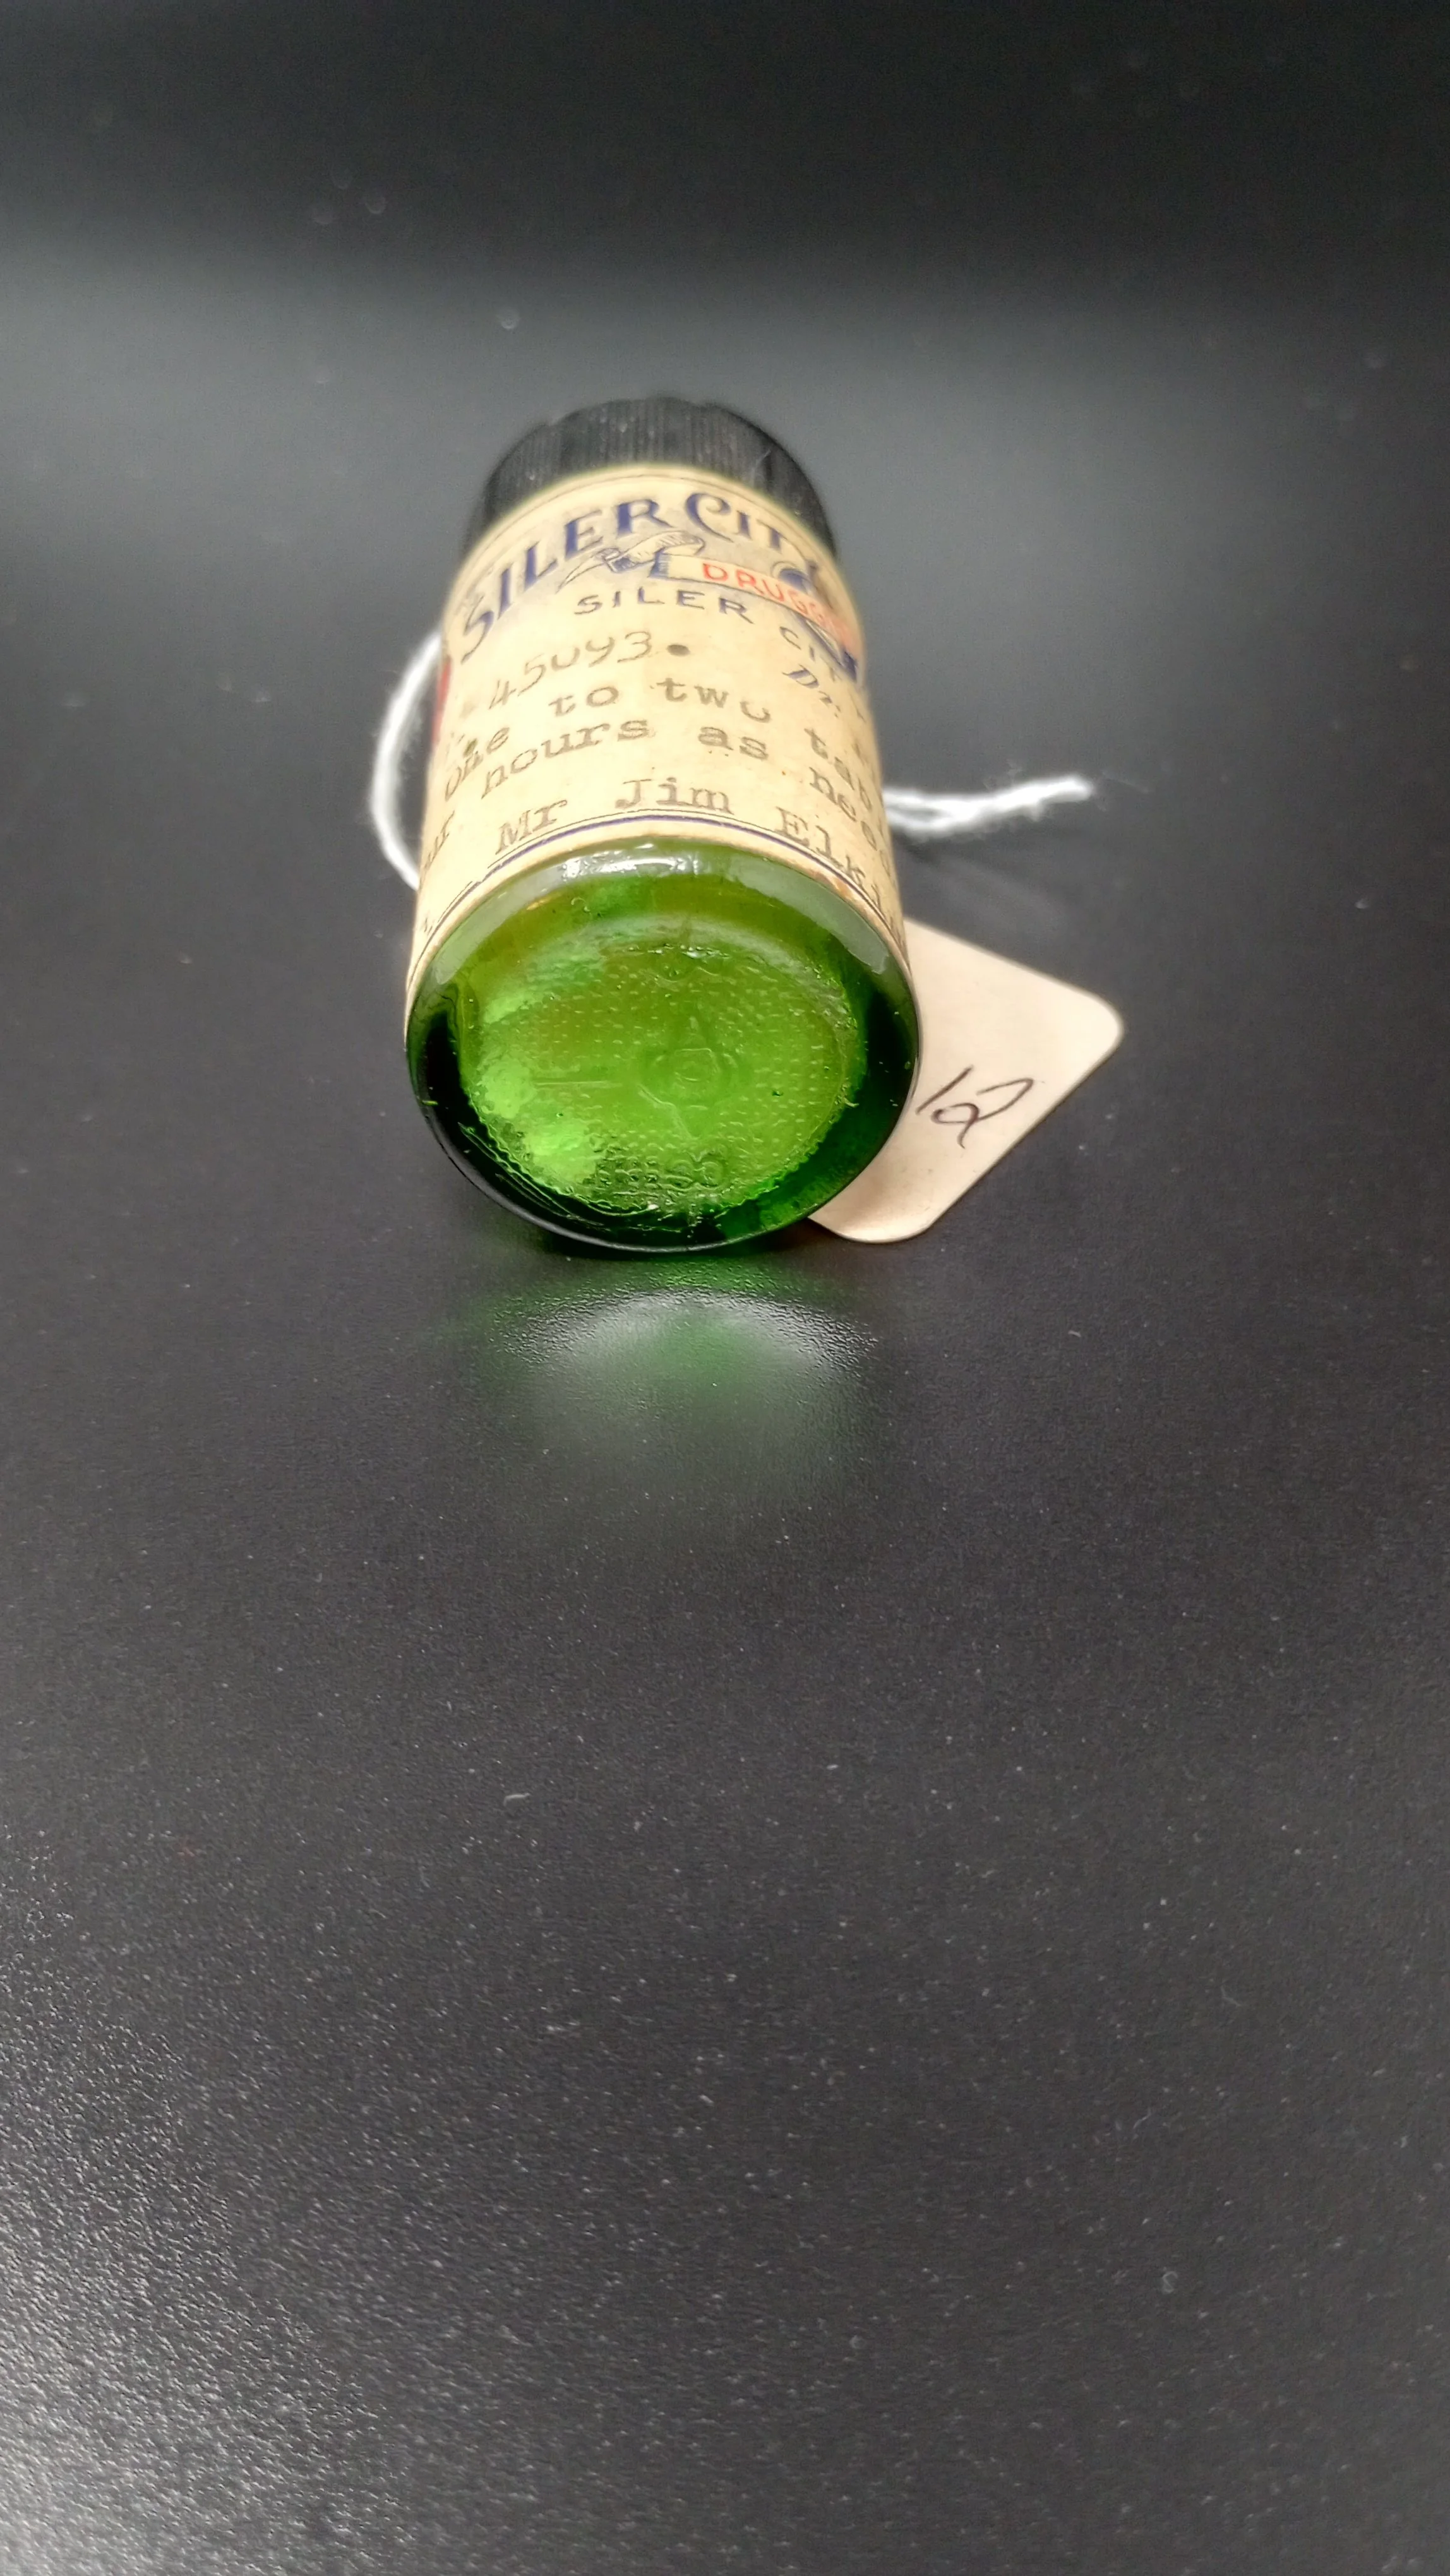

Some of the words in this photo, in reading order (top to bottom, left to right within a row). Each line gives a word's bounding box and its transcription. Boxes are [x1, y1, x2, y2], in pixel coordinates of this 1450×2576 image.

[460, 498, 674, 665] SILER
[573, 586, 755, 624] SILER
[548, 686, 620, 717] to
[698, 727, 769, 760] as
[494, 799, 568, 855] Mr
[615, 777, 734, 815] Jim
[916, 1064, 1034, 1149] 12
